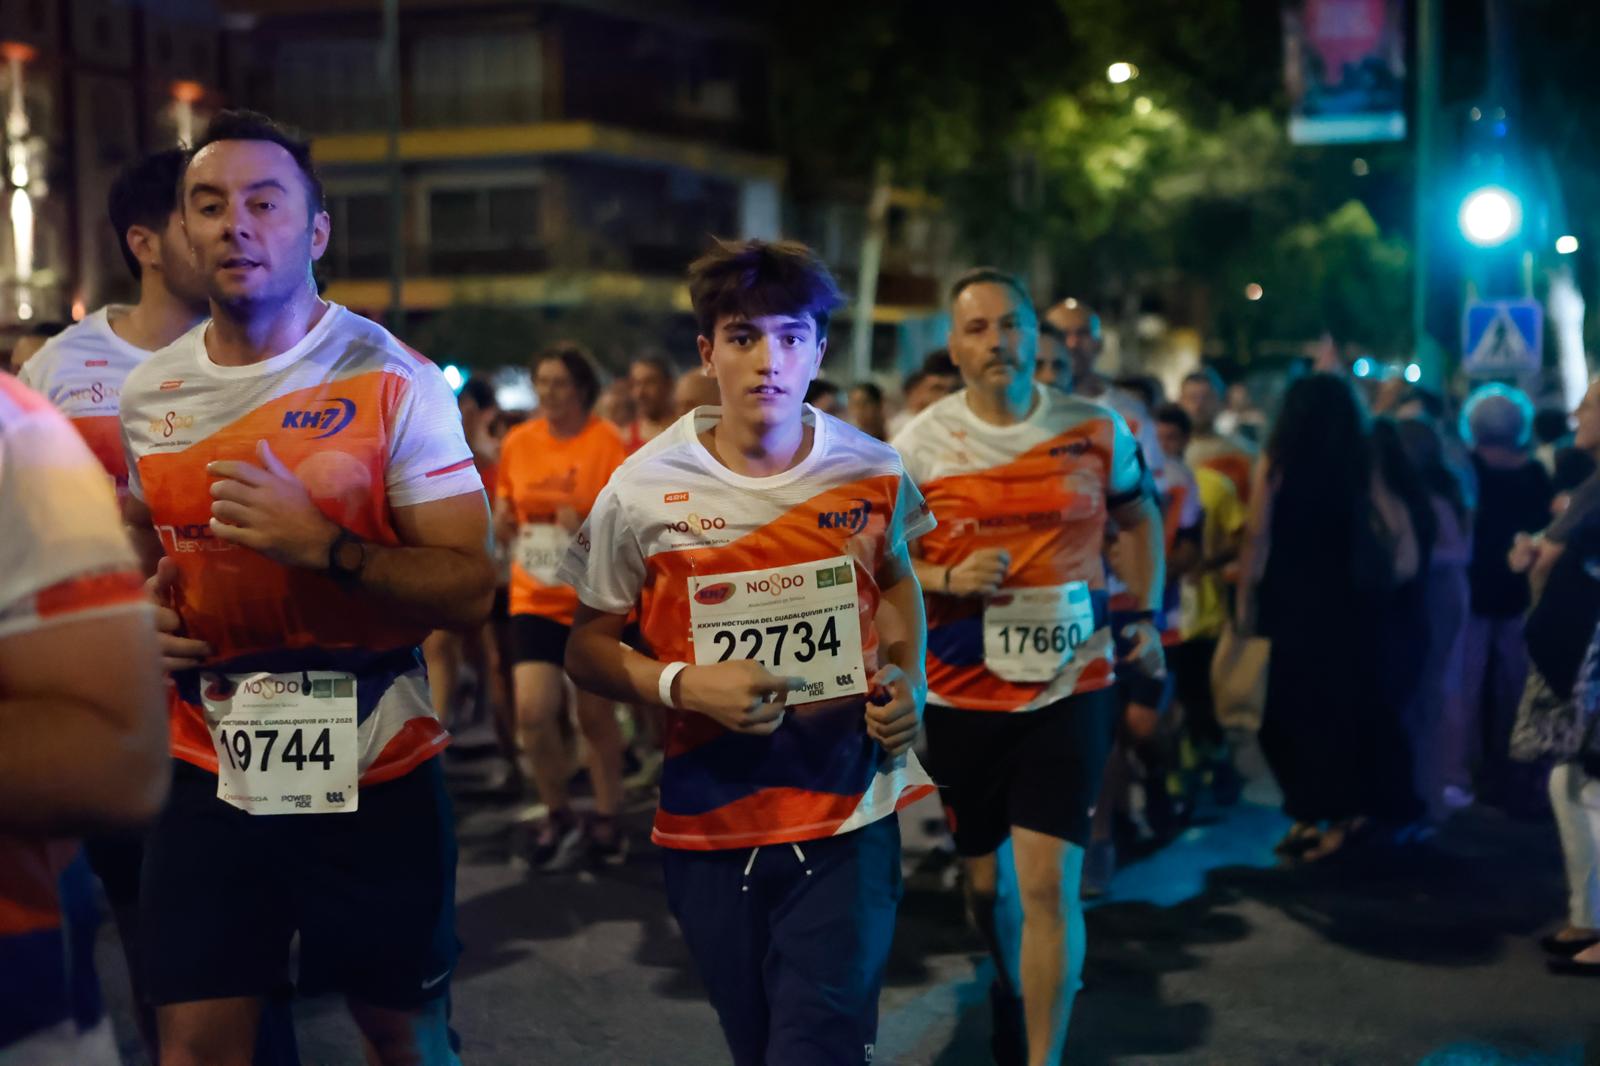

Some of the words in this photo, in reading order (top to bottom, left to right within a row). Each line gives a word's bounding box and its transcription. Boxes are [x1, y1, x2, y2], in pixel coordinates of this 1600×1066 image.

[722, 618, 760, 627] NOCTURNA
[760, 616, 774, 624] DEL
[774, 608, 823, 622] GUADALQUIVIR
[713, 615, 841, 667] 22734
[998, 623, 1082, 655] 17660
[264, 718, 317, 727] GUADALQUIVIR
[220, 728, 335, 772] 19744
